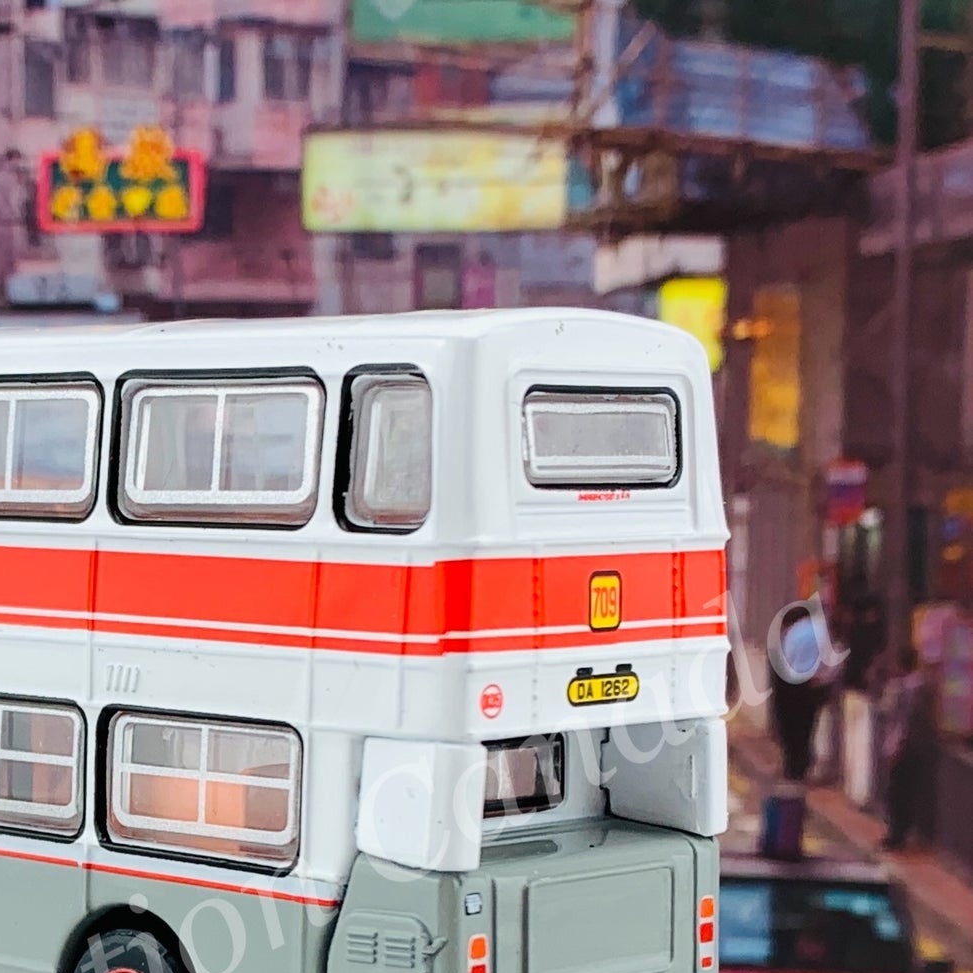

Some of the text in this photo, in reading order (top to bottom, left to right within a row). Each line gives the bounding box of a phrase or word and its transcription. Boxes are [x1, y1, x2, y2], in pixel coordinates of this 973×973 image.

[592, 586, 619, 619] 709
[577, 678, 631, 701] DA 1262
